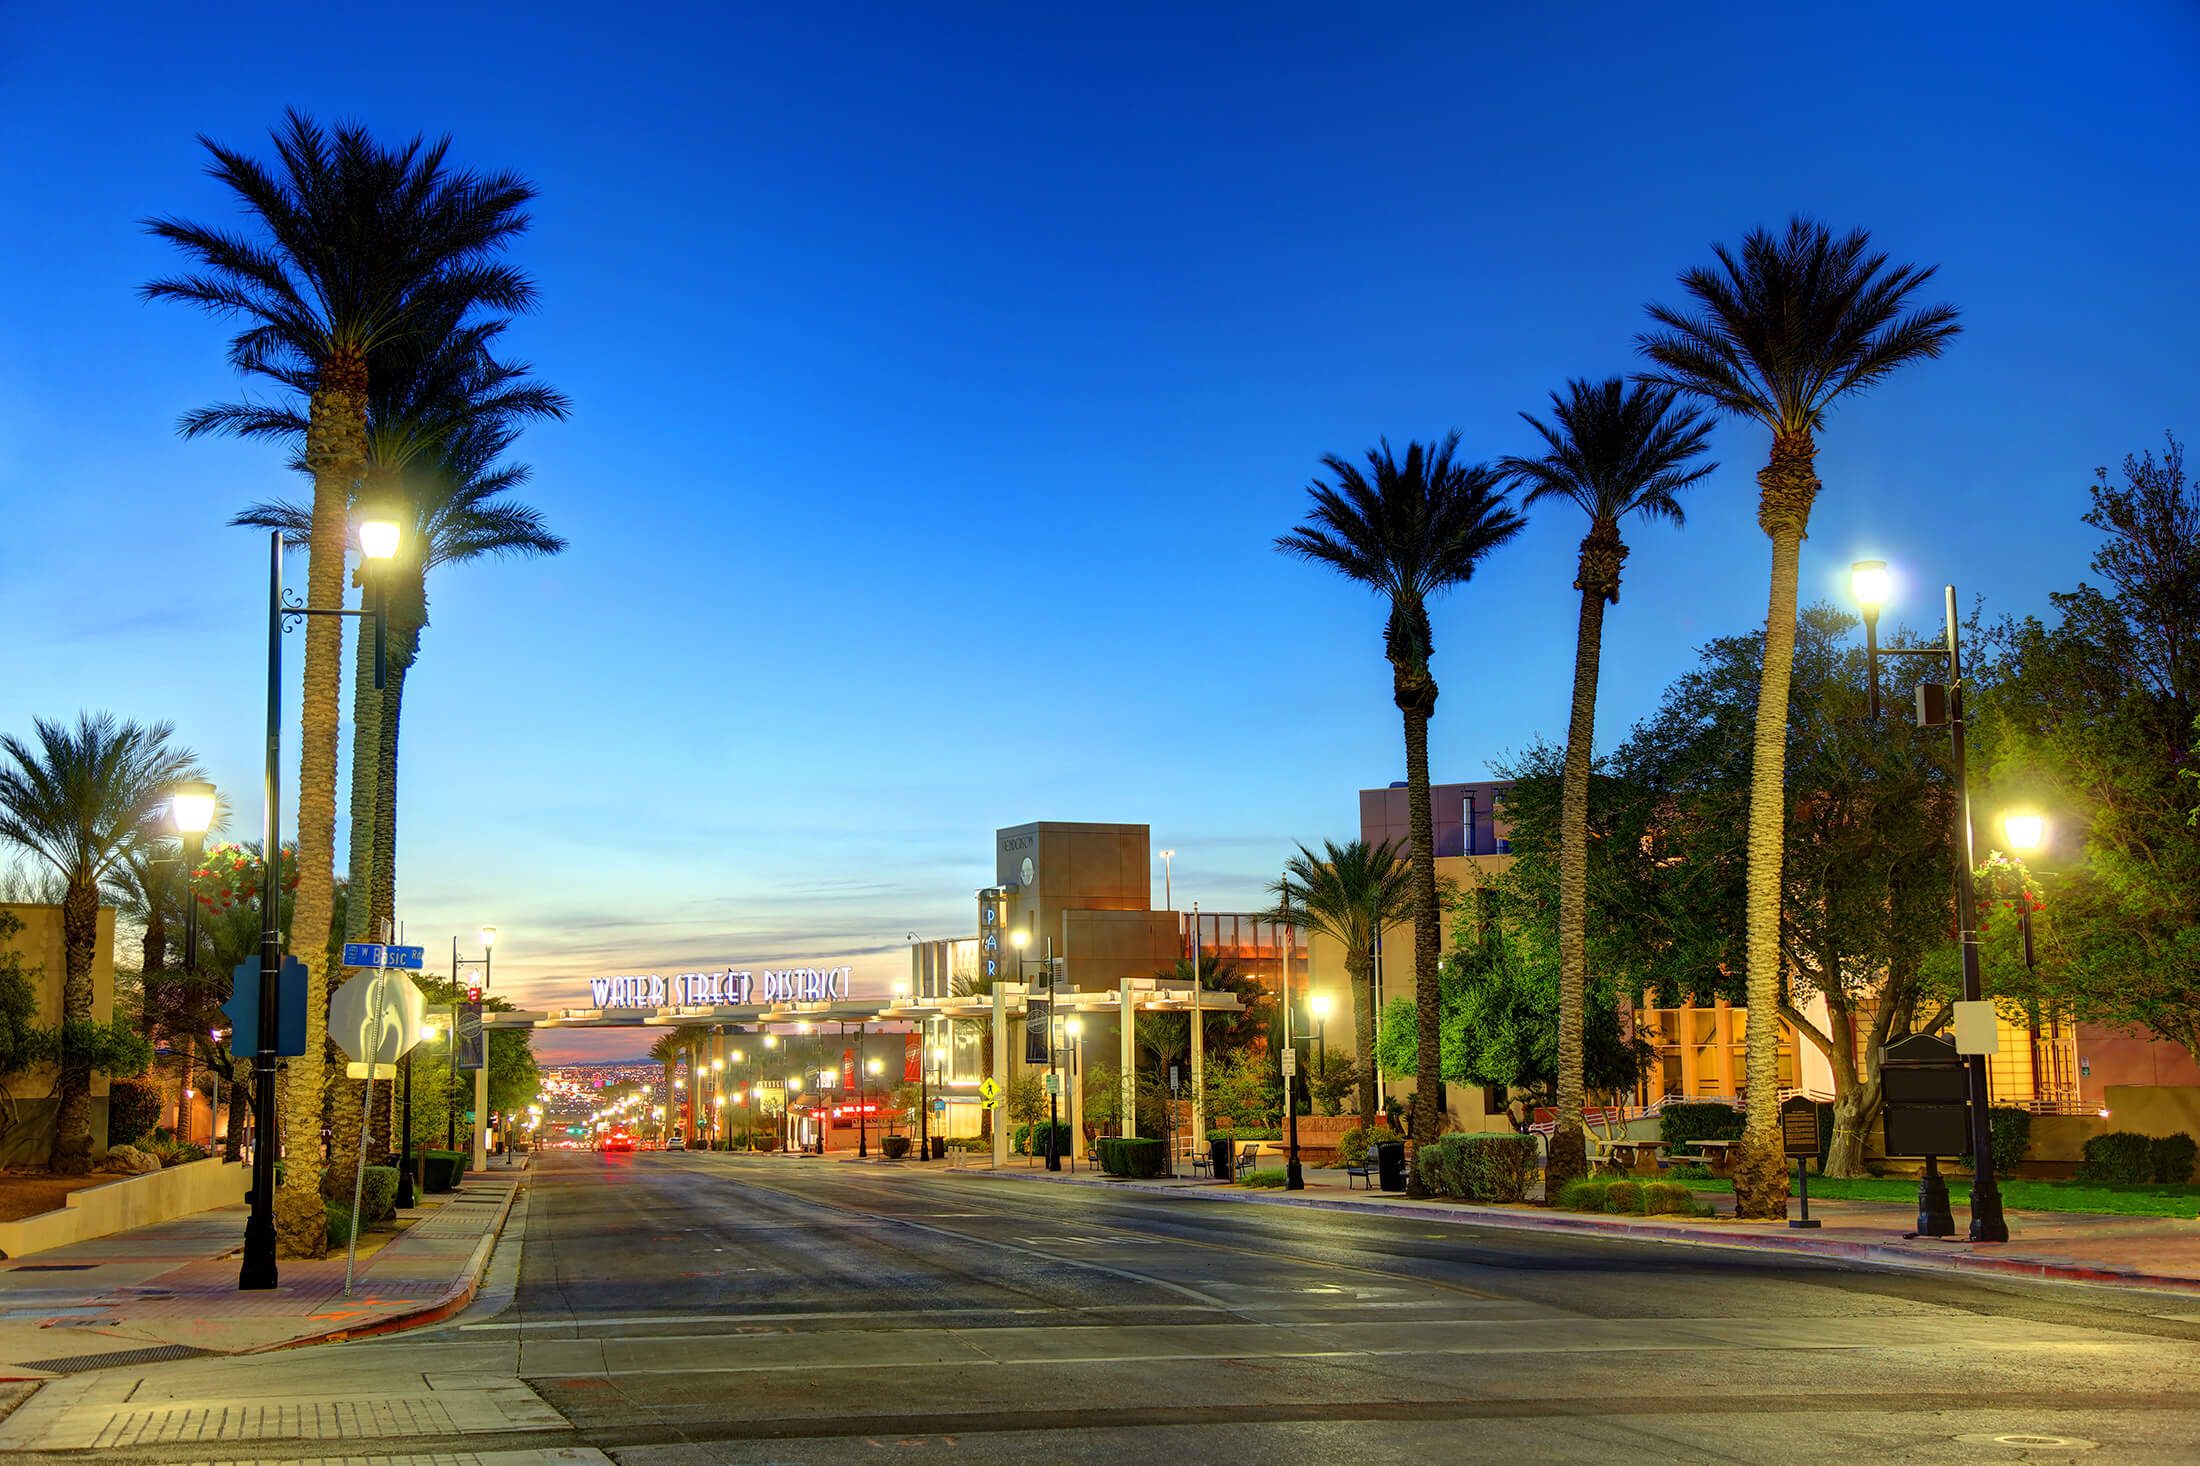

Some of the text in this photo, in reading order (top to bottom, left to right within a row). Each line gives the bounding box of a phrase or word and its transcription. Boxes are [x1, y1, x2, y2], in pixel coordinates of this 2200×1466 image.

[361, 947, 369, 957] W
[373, 947, 407, 965] Basic
[591, 966, 852, 1007] WATER STREET DISTRICT
